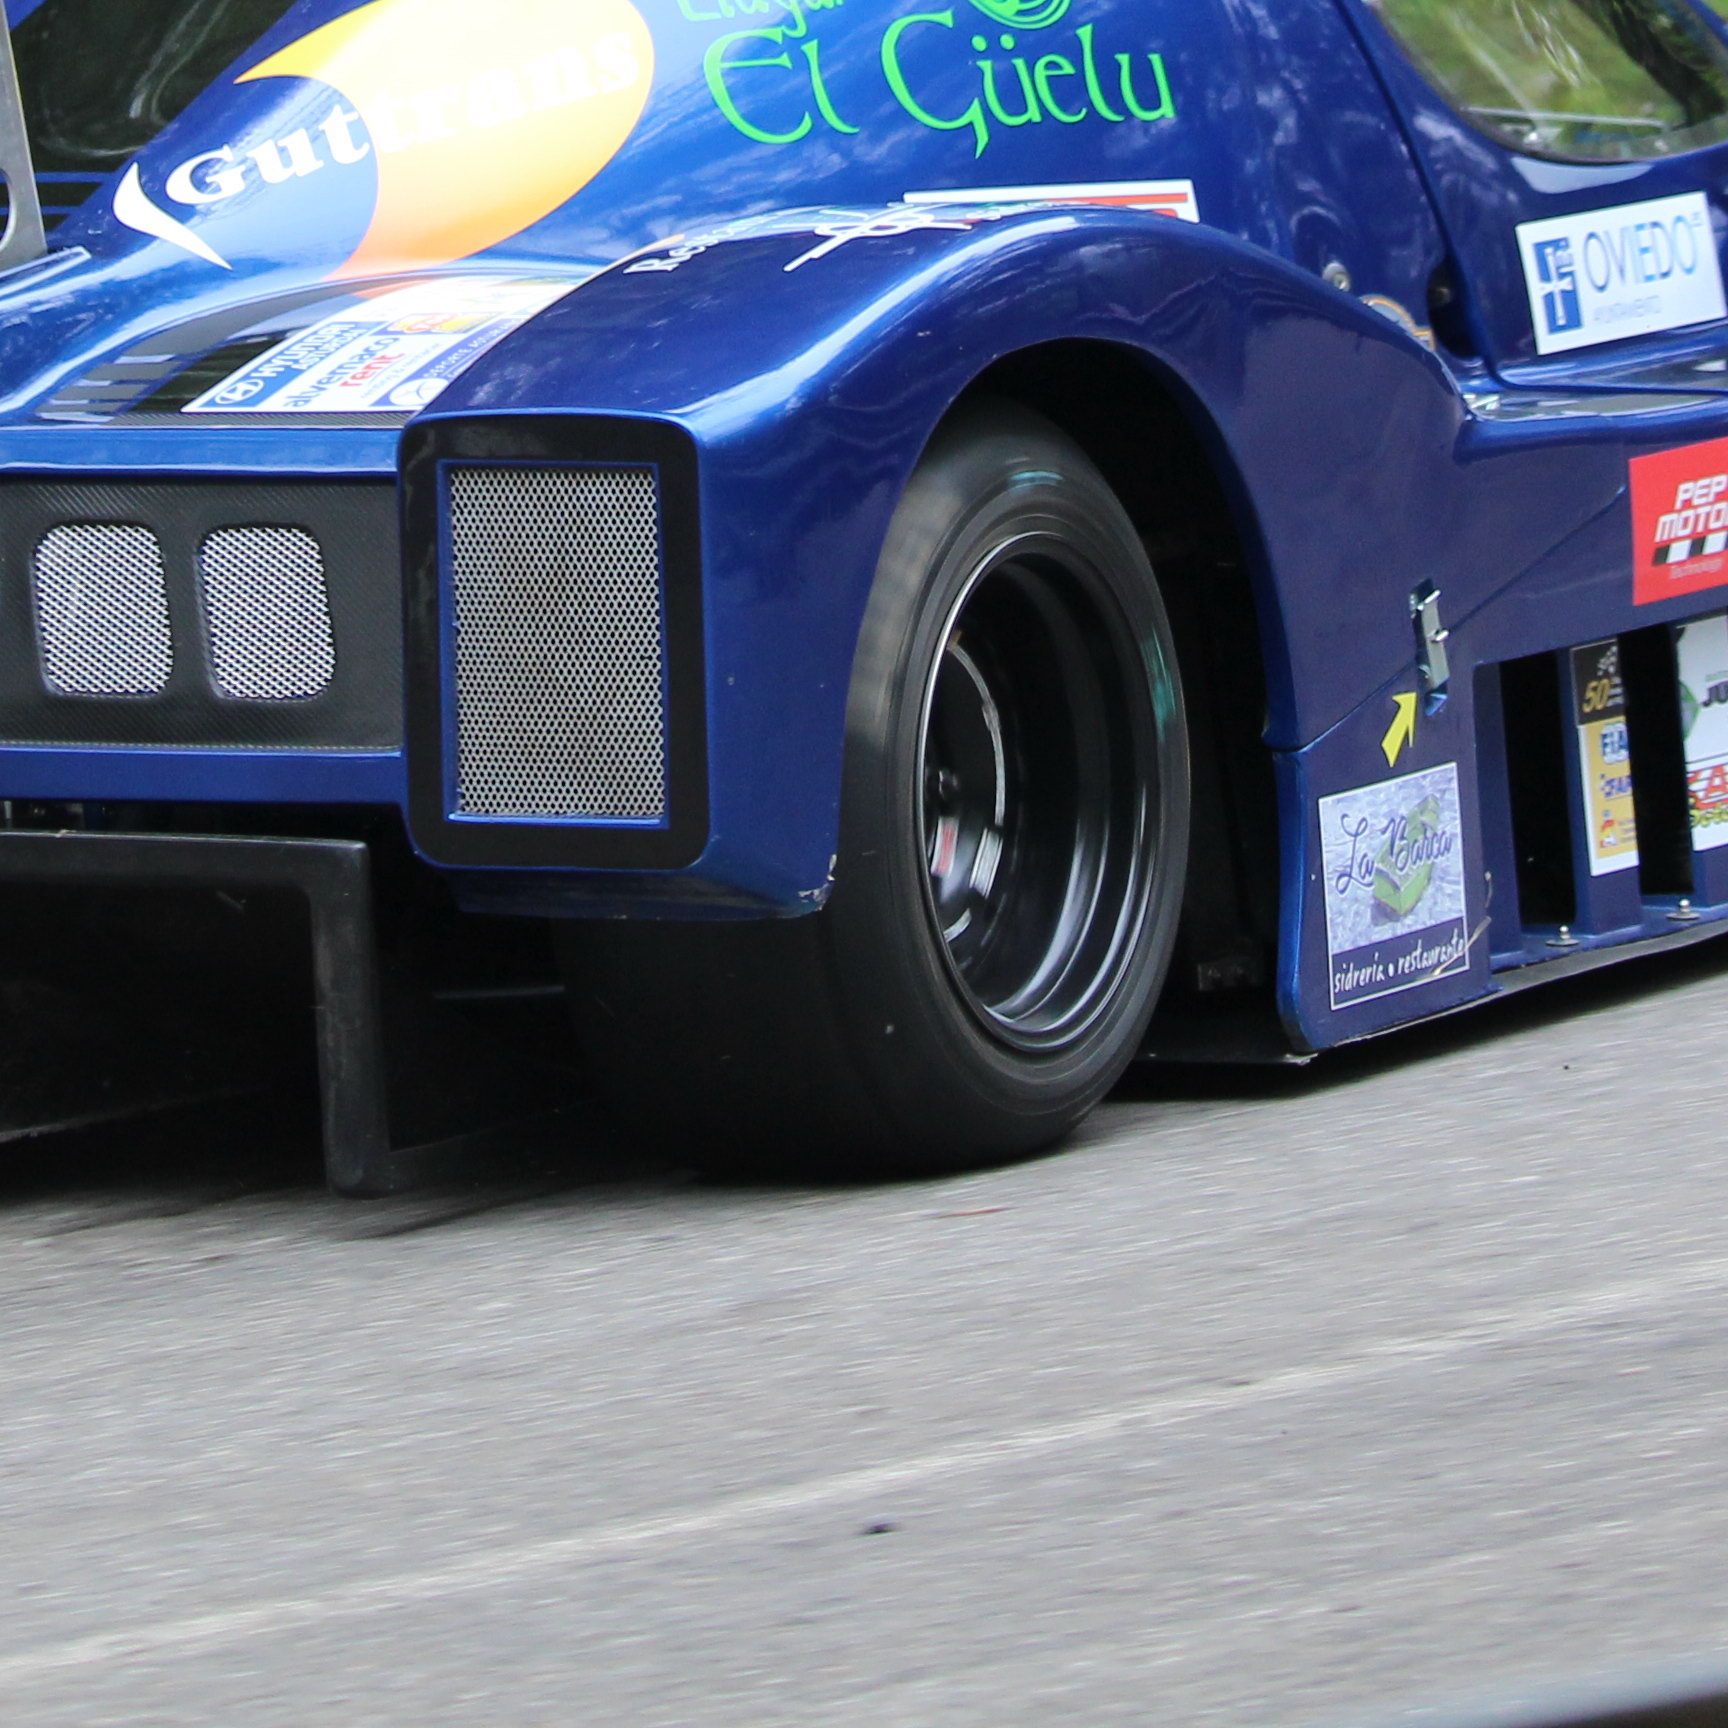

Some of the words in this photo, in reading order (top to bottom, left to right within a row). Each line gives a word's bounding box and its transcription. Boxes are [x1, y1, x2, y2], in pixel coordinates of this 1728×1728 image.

[703, 28, 859, 144] El
[881, 11, 1176, 159] Güelu
[1583, 215, 1698, 293] OVIEDO
[250, 323, 356, 378] HYUNDAI
[340, 353, 406, 387] rent
[1582, 678, 1612, 713] 50
[1335, 813, 1376, 895] La
[1381, 815, 1453, 872] Barca
[1397, 927, 1465, 972] restaurante
